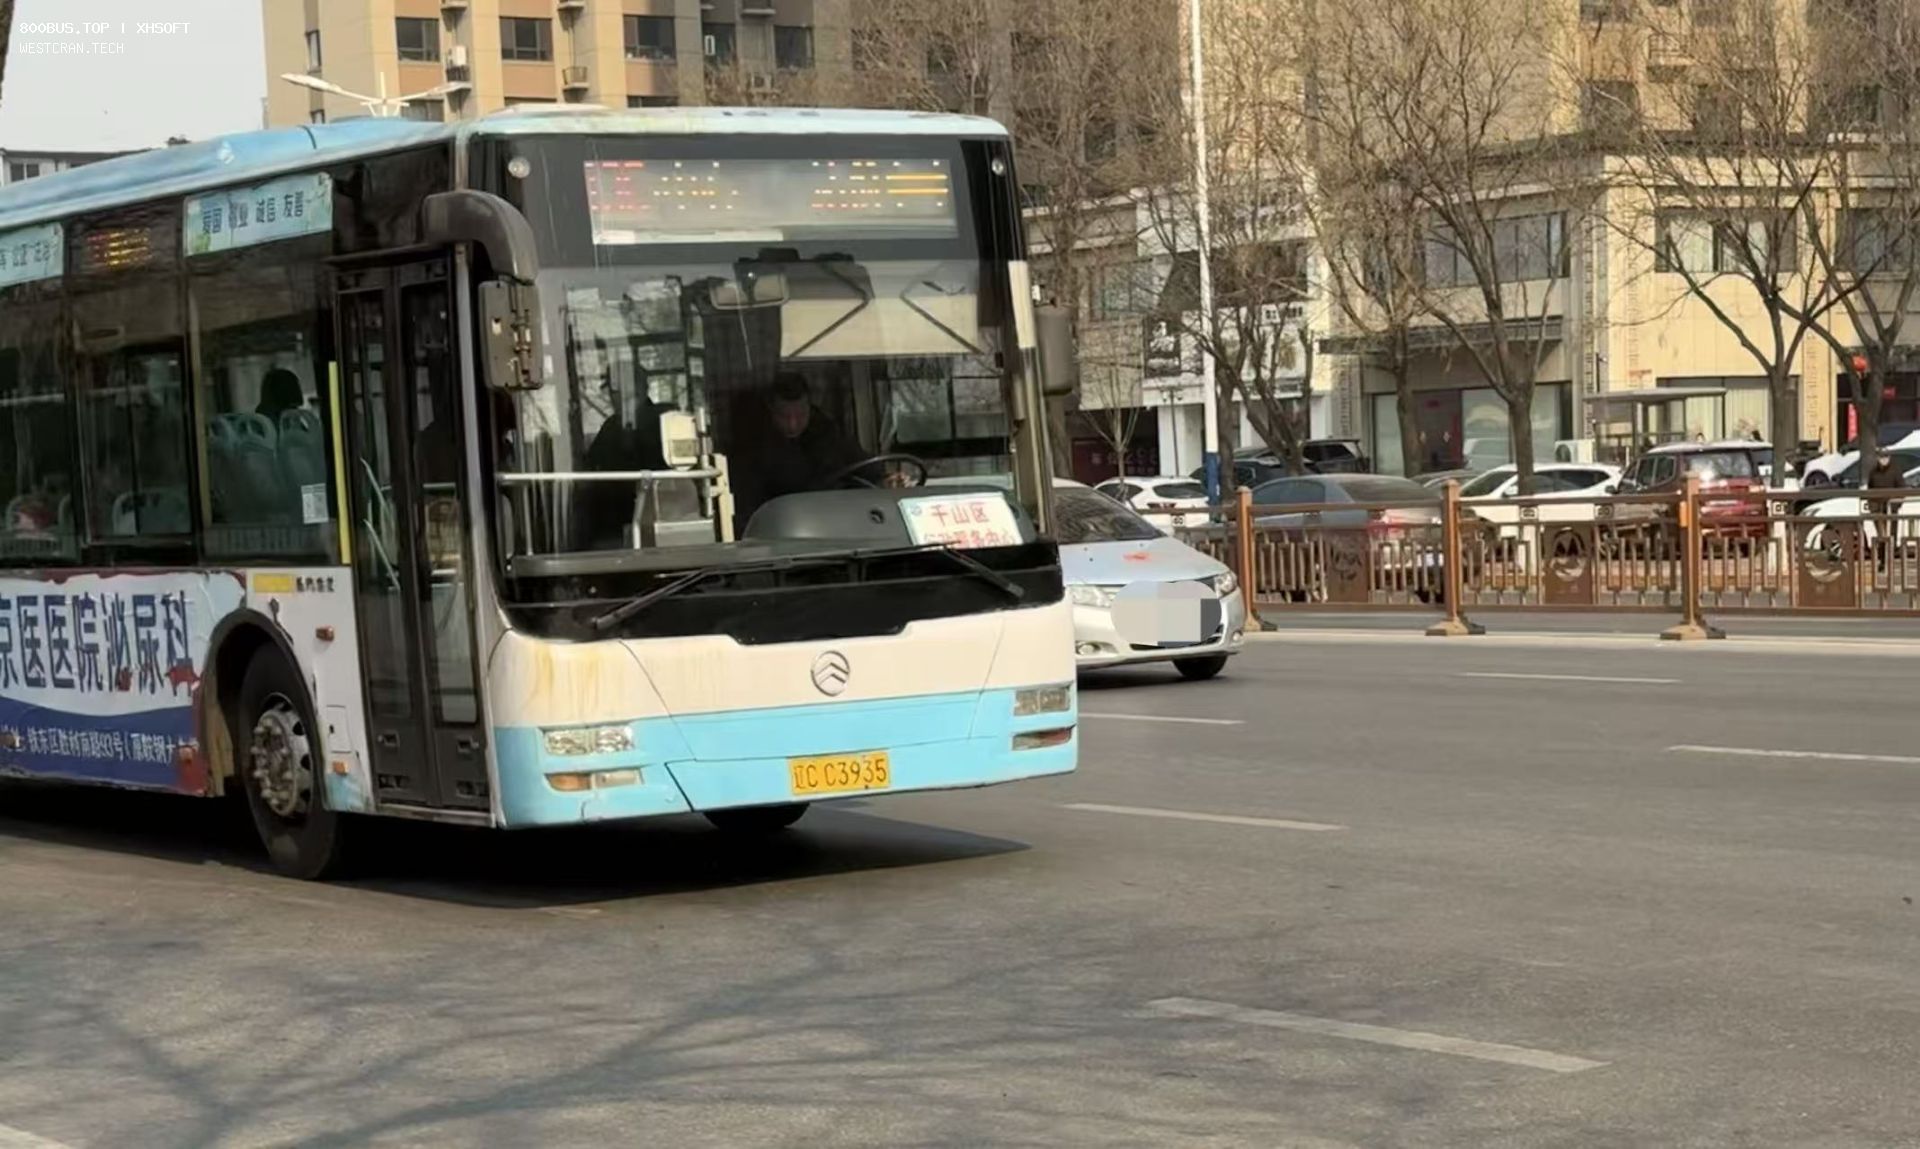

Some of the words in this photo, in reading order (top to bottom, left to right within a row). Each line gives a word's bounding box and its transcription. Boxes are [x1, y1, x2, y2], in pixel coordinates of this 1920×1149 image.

[931, 502, 989, 527] 千山区
[824, 758, 887, 787] C3935
